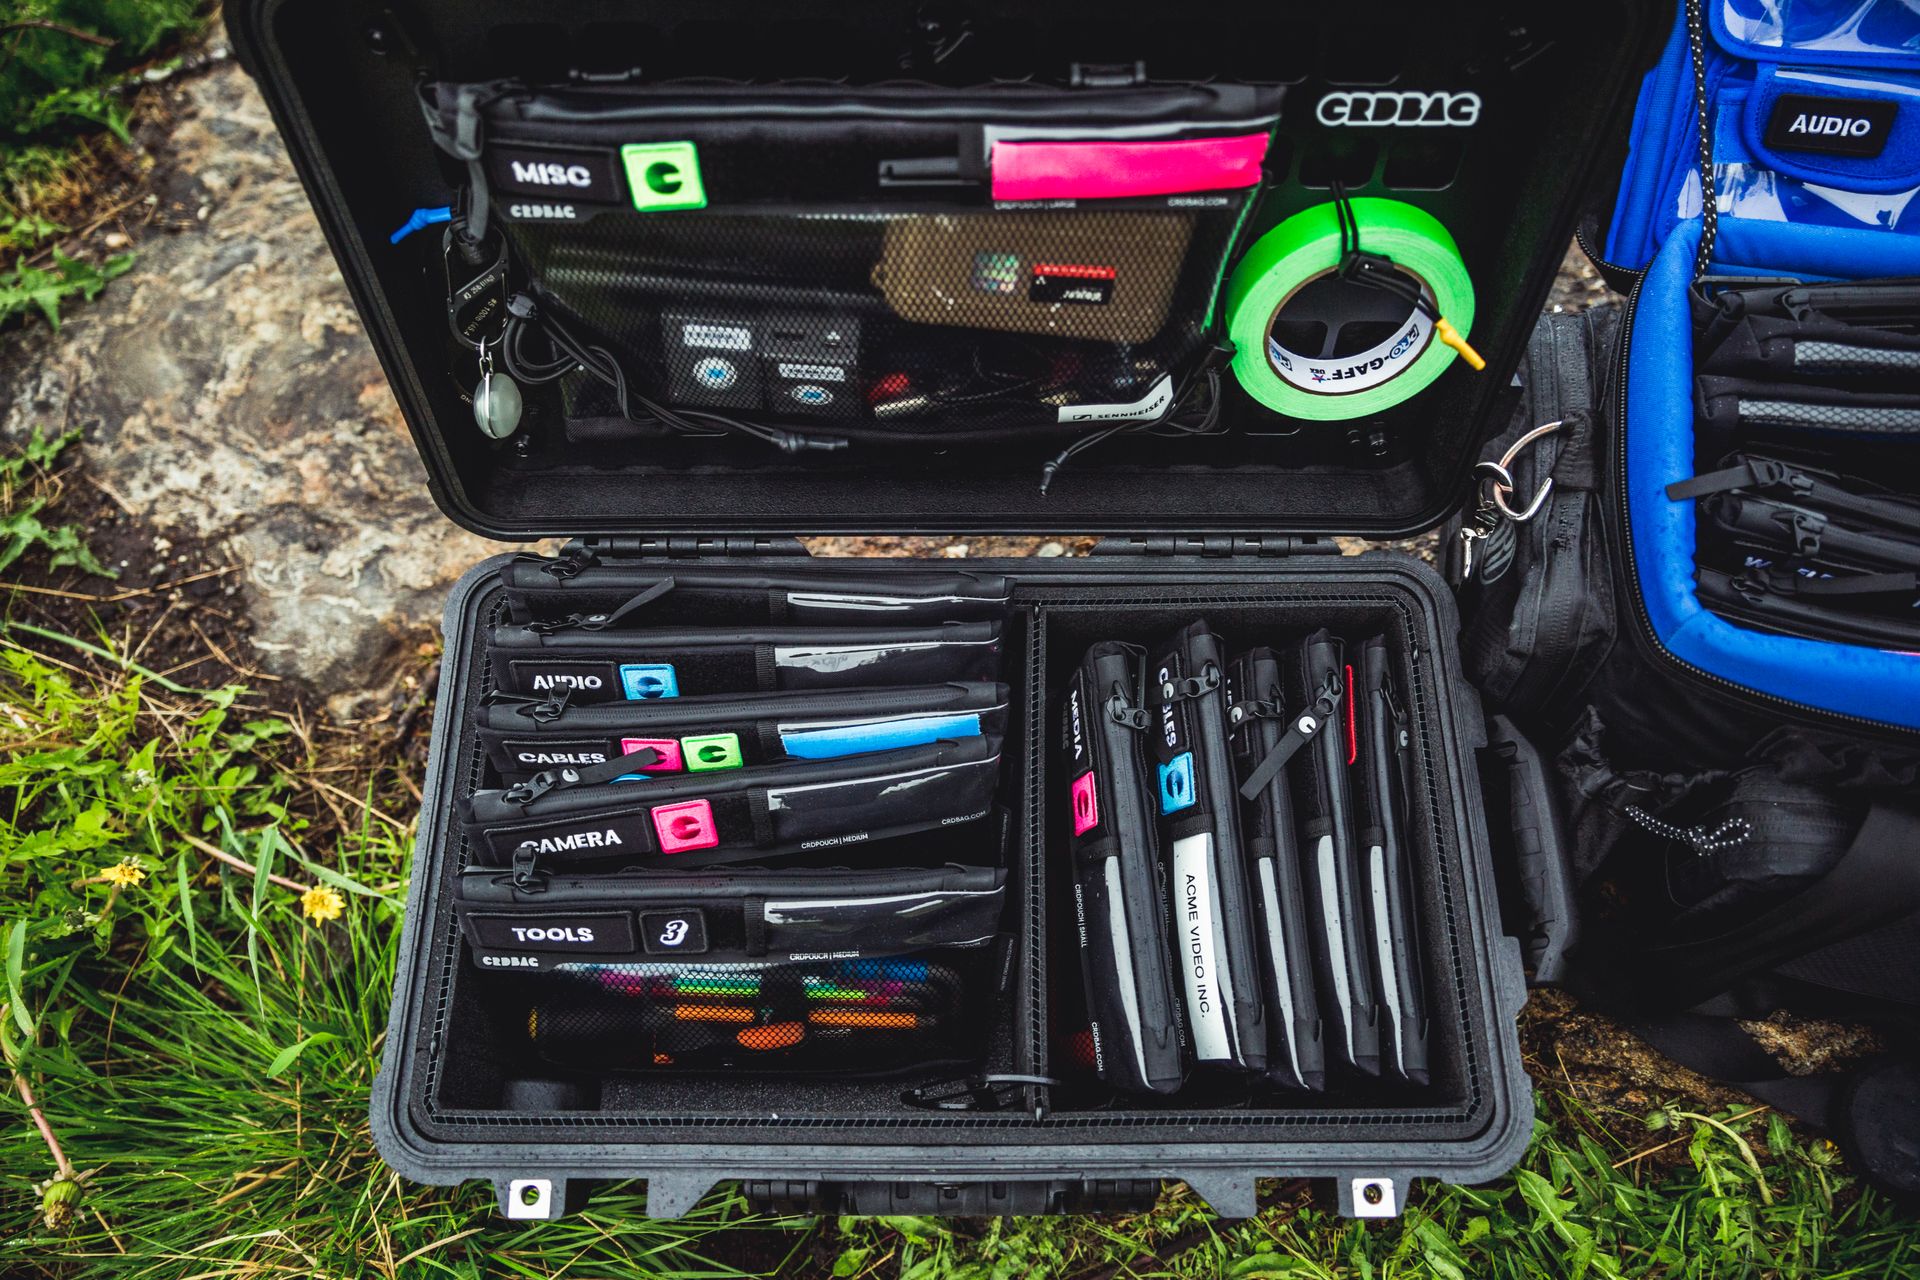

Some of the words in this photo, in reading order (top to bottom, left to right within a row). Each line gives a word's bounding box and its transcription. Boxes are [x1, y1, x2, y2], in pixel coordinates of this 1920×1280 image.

[1316, 92, 1481, 126] CRDBAG
[1788, 114, 1871, 137] AUDIO
[511, 160, 592, 187] MISC
[1097, 395, 1165, 419] SENNHEISER
[1159, 667, 1177, 747] CBLES
[1070, 689, 1083, 760] MEDIA
[518, 753, 606, 764] CABLES
[941, 810, 986, 825] CRDBAG.COM
[801, 838, 839, 849] CRDPOUCH
[842, 833, 869, 843] MEDIUM
[1074, 884, 1085, 922] CRDPOUCH
[1186, 874, 1199, 921] ACME
[511, 927, 594, 942] TOOLS
[659, 919, 689, 946] 3
[1079, 926, 1088, 948] SMALL
[482, 956, 539, 967] CRDBAG
[1190, 925, 1204, 979] VIDEO
[1197, 984, 1209, 1018] INC.
[1091, 1021, 1104, 1071] CRDBAG.COM
